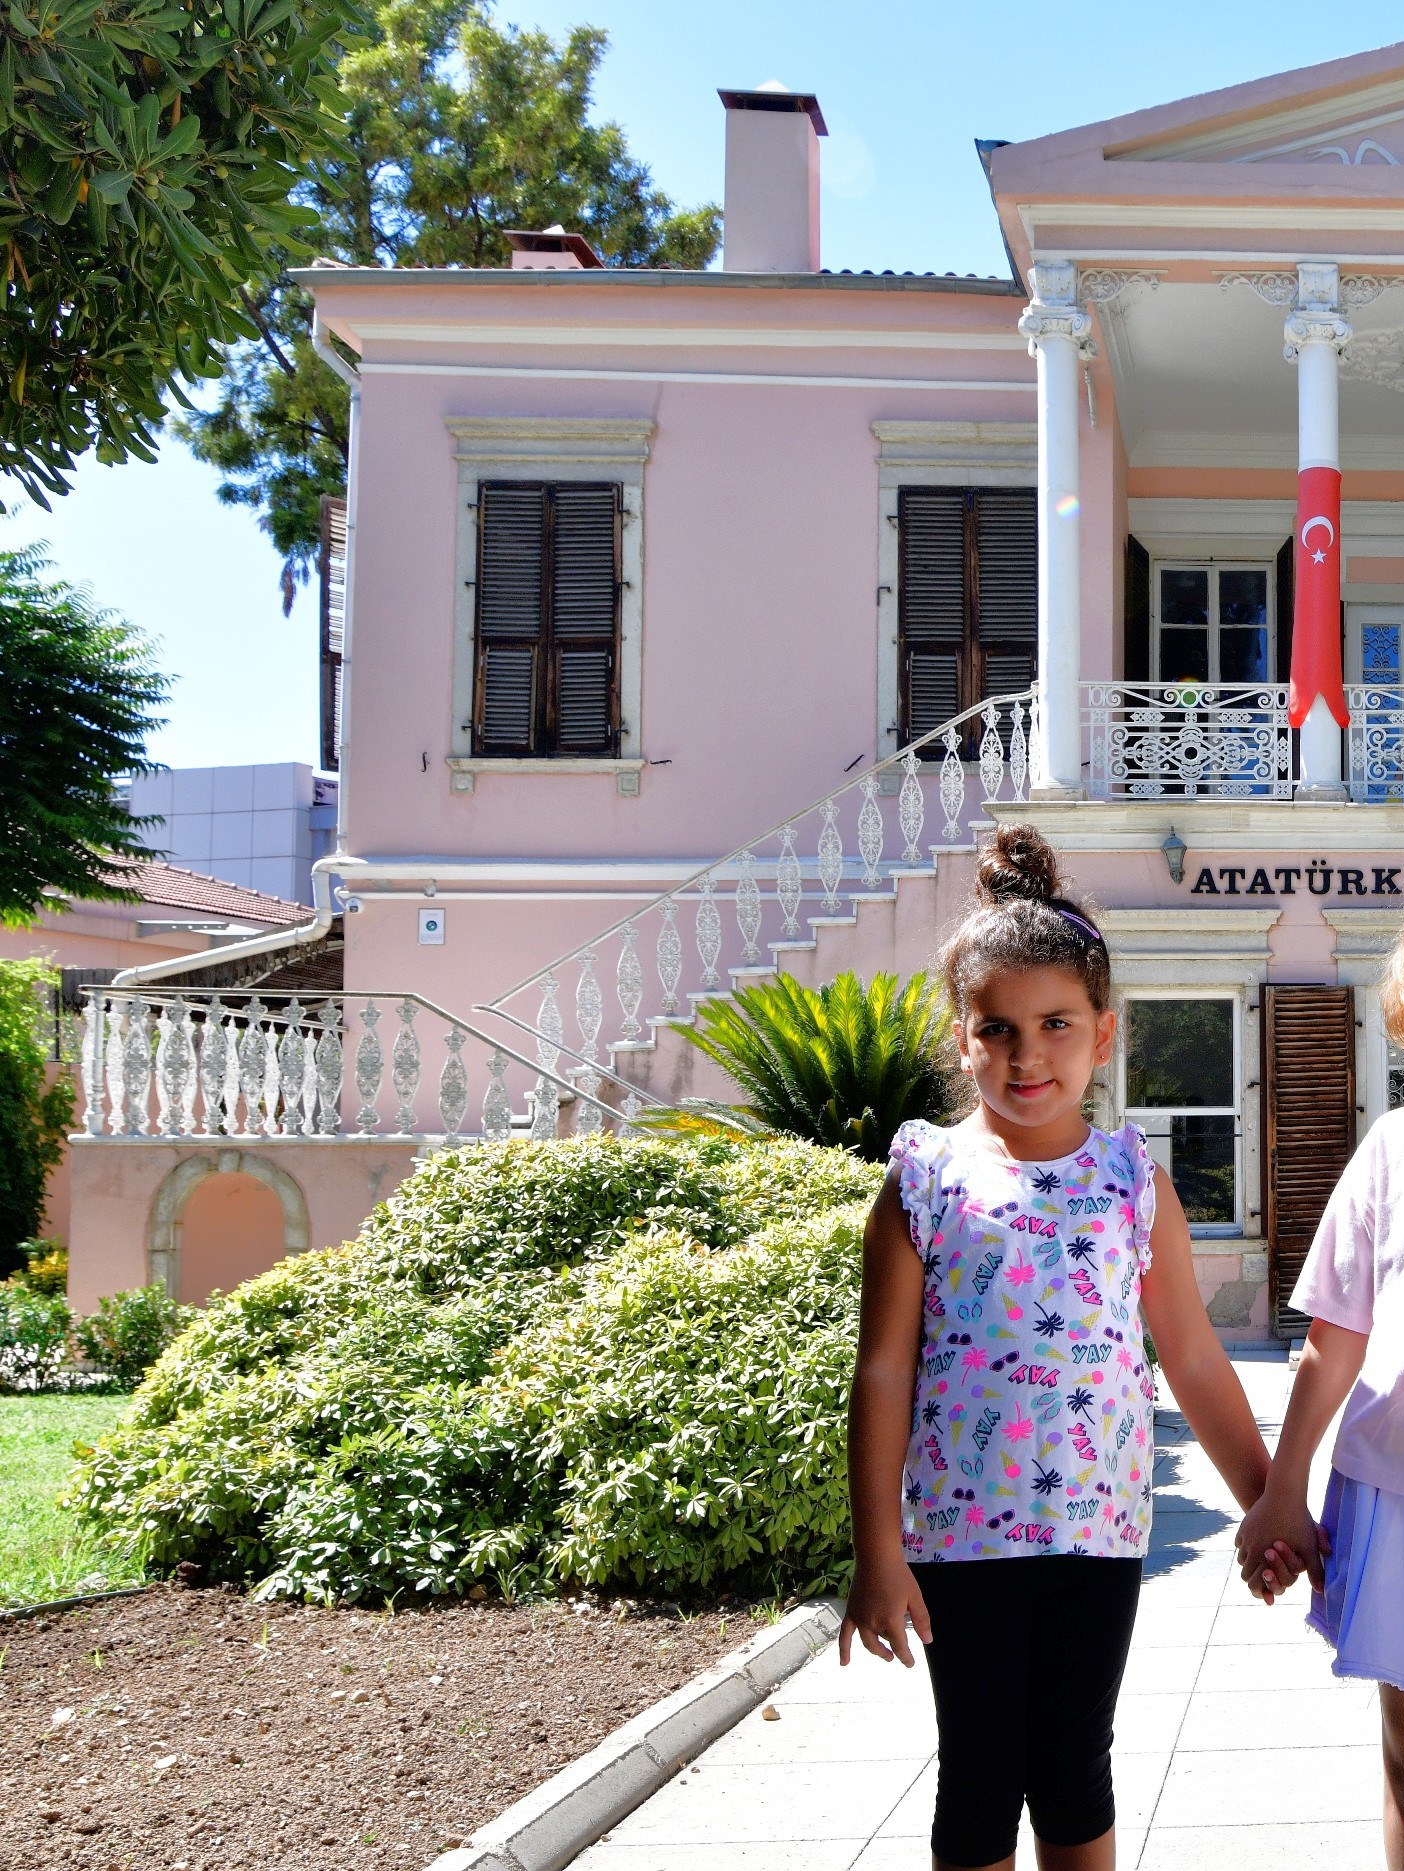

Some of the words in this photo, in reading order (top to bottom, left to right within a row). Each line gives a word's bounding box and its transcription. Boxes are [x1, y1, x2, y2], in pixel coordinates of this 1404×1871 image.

[1190, 859, 1403, 896] ATATÜRK
[1067, 1196, 1112, 1215] YAY
[1009, 1214, 1059, 1239] YAY
[972, 1252, 1003, 1296] YAY
[1069, 1268, 1103, 1306] YAY
[926, 1350, 956, 1377] YAY
[1072, 1343, 1112, 1364] YAY
[1008, 1364, 1060, 1388] YAY
[972, 1407, 1001, 1451] YAY
[1067, 1422, 1098, 1461] YAY
[1115, 1409, 1135, 1450] YAY
[925, 1434, 948, 1471] YAY
[926, 1506, 960, 1531] YAY
[1066, 1498, 1100, 1521] YAY
[1004, 1522, 1056, 1545] YAY
